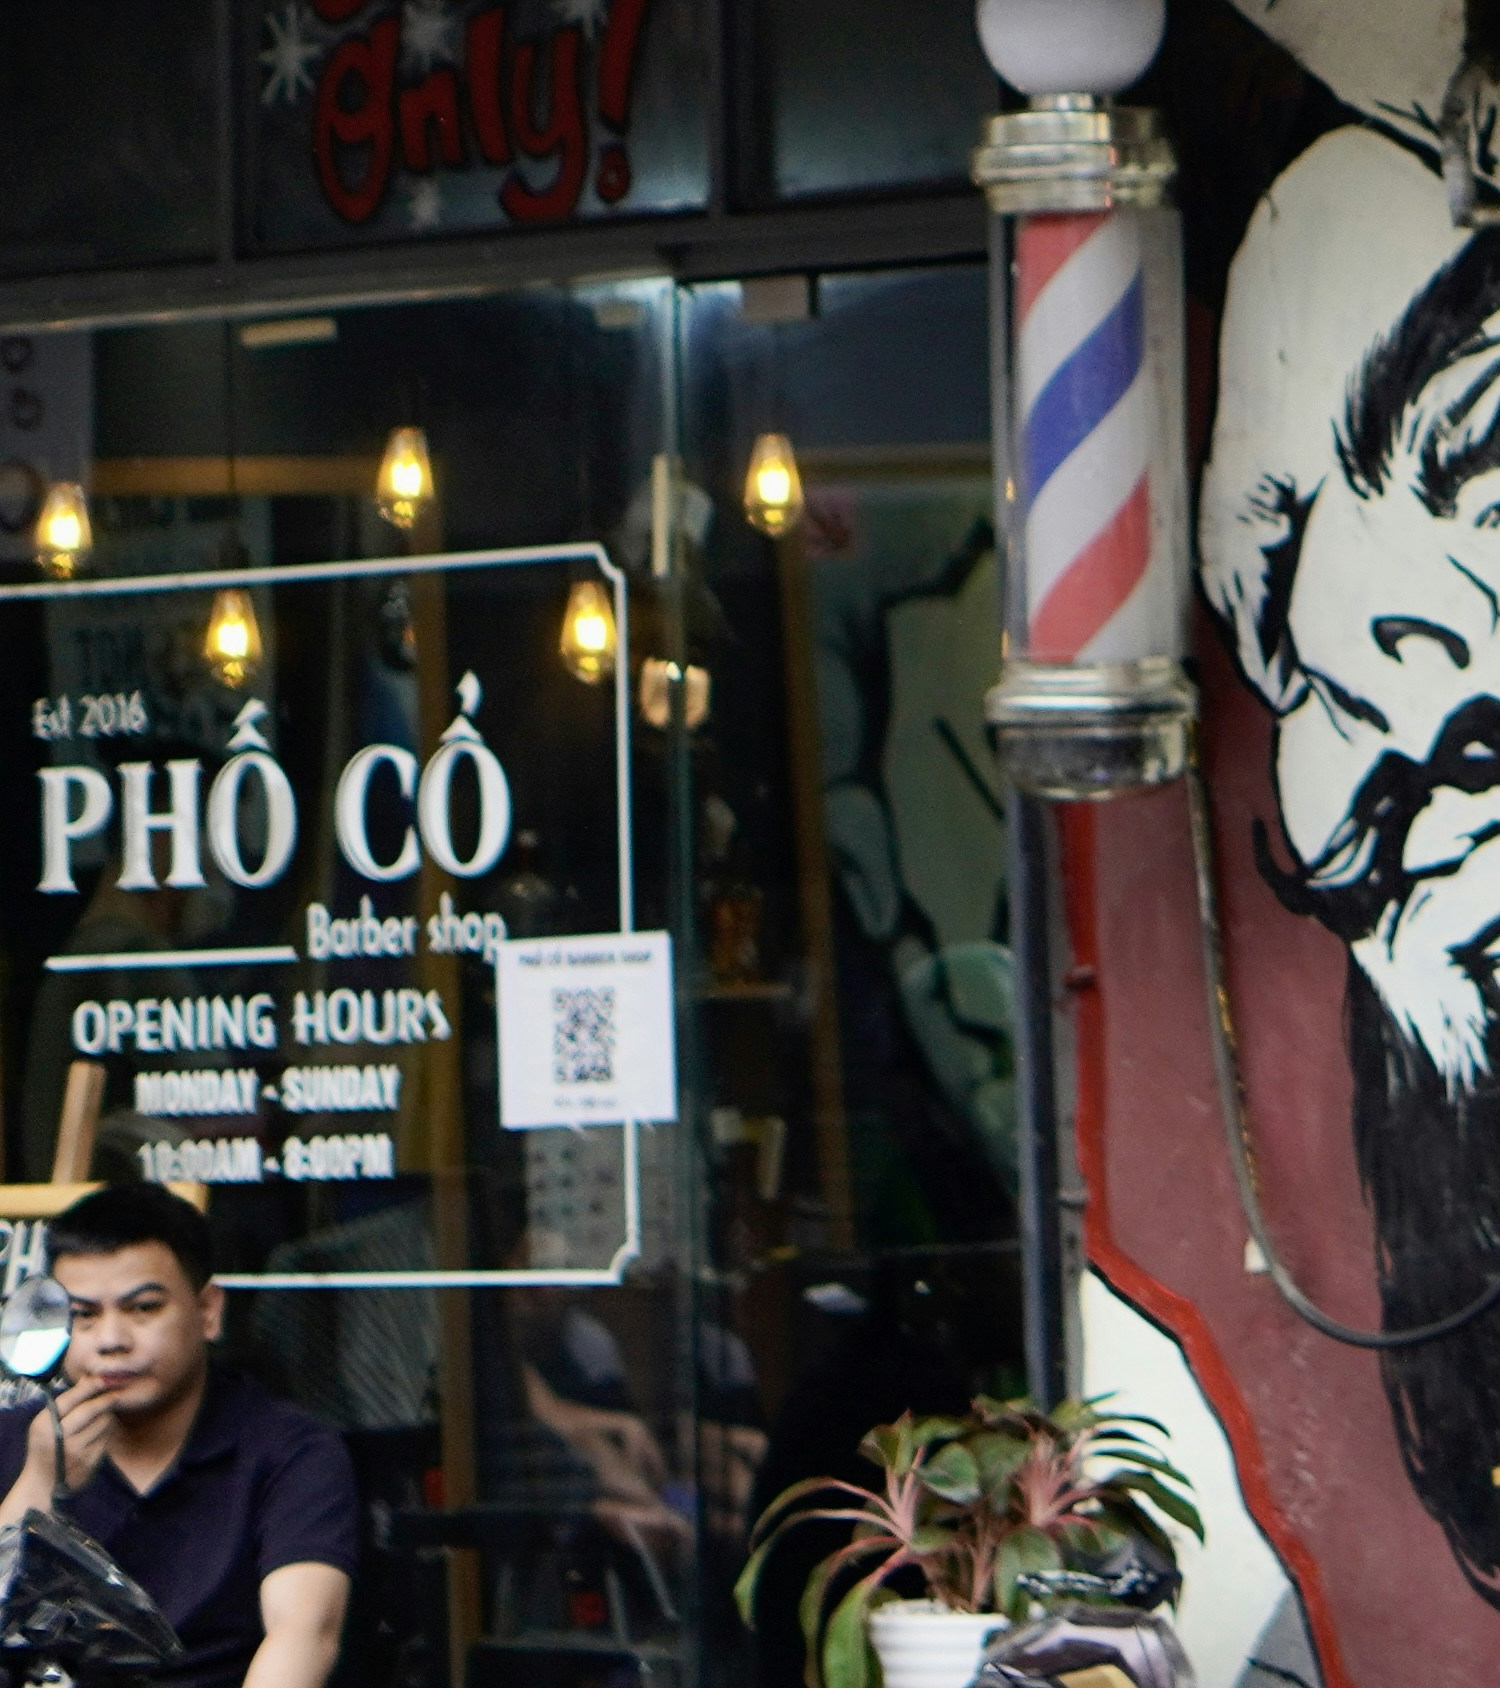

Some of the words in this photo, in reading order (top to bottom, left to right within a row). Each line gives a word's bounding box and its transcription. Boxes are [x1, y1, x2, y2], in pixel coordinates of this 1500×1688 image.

[78, 689, 148, 738] 2016
[34, 698, 297, 894] PHỐ
[335, 670, 513, 882] CỔ
[306, 894, 419, 961] Barber
[427, 891, 508, 966] shop
[71, 992, 278, 1055] OPENING
[291, 988, 452, 1046] HOURS
[135, 1068, 258, 1116] MONDAY
[281, 1064, 401, 1111] SUNDAY
